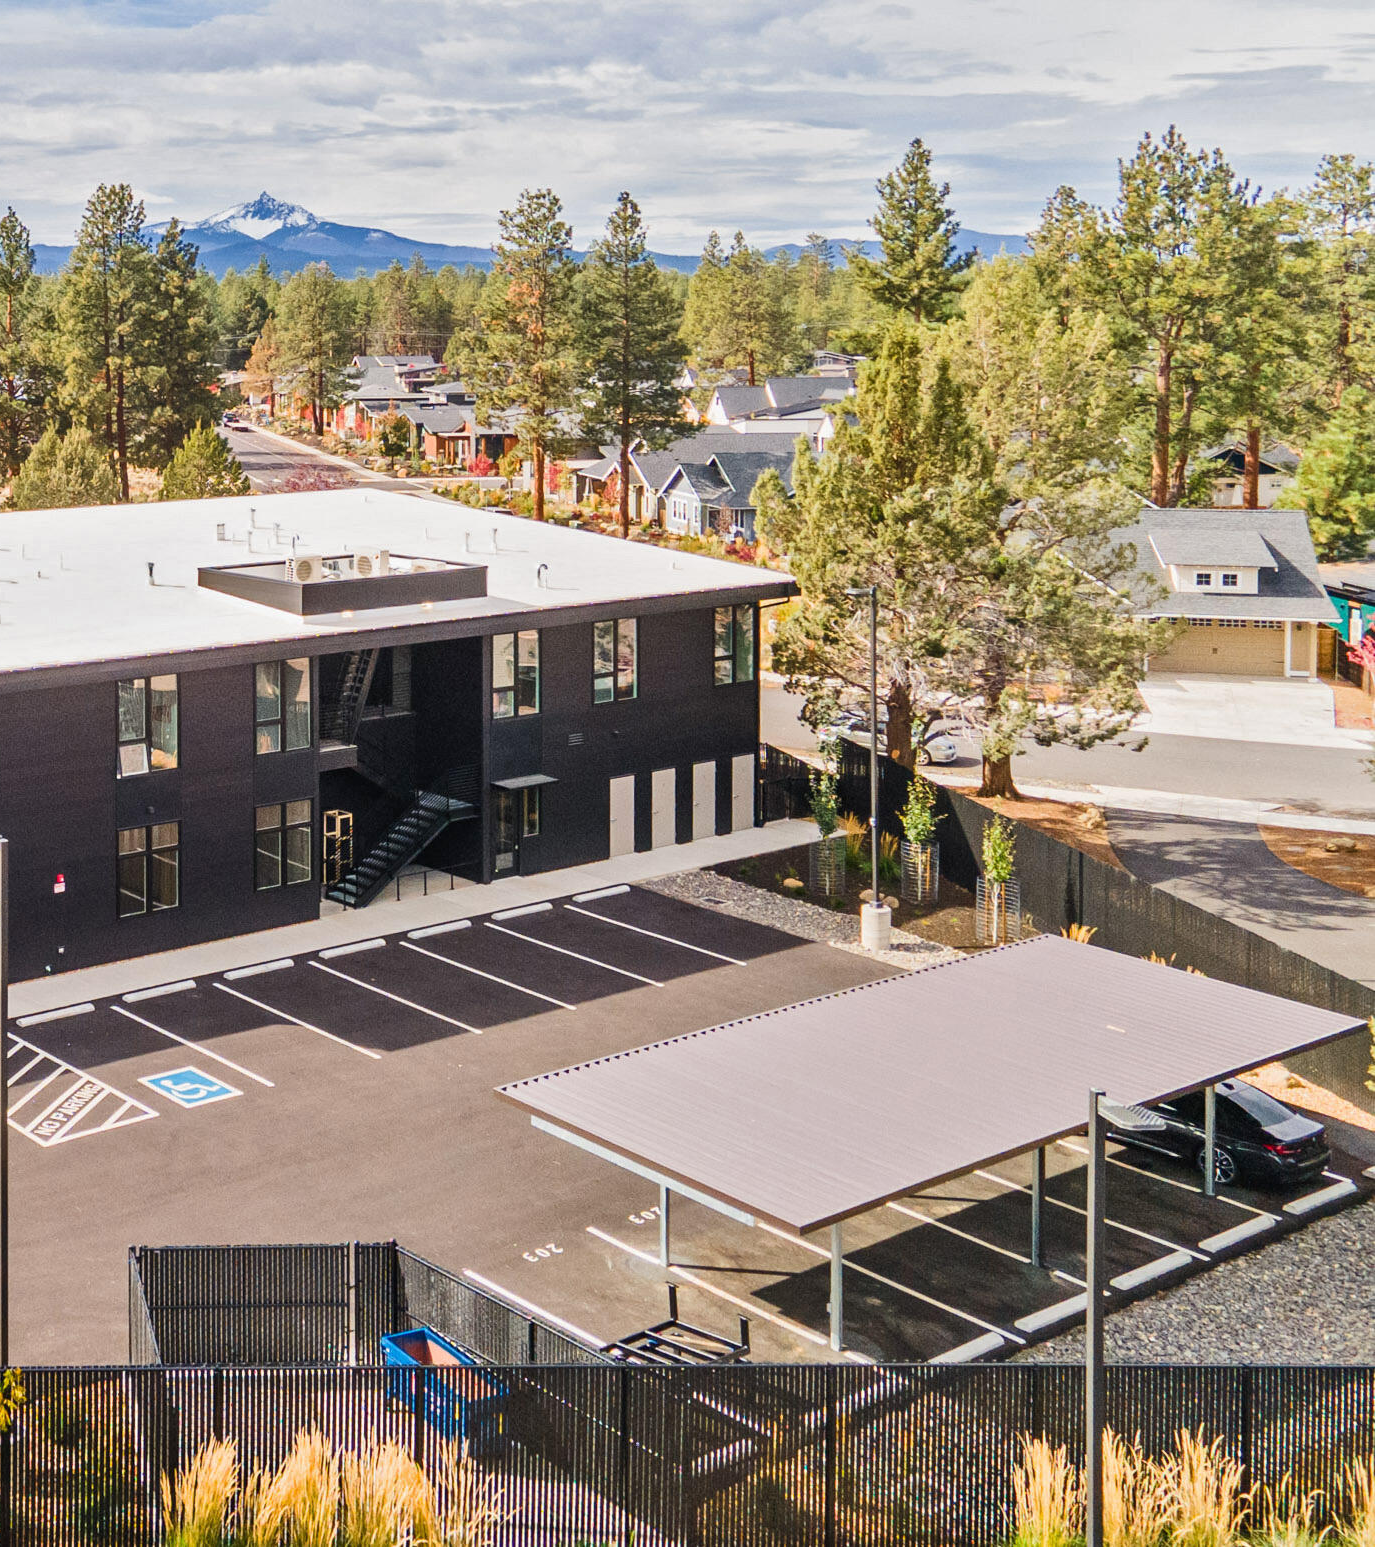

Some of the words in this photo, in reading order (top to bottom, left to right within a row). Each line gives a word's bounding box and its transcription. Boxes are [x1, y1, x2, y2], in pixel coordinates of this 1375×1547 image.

[33, 1121, 61, 1136] NO
[50, 1083, 102, 1122] PARKING
[522, 1243, 564, 1262] 203
